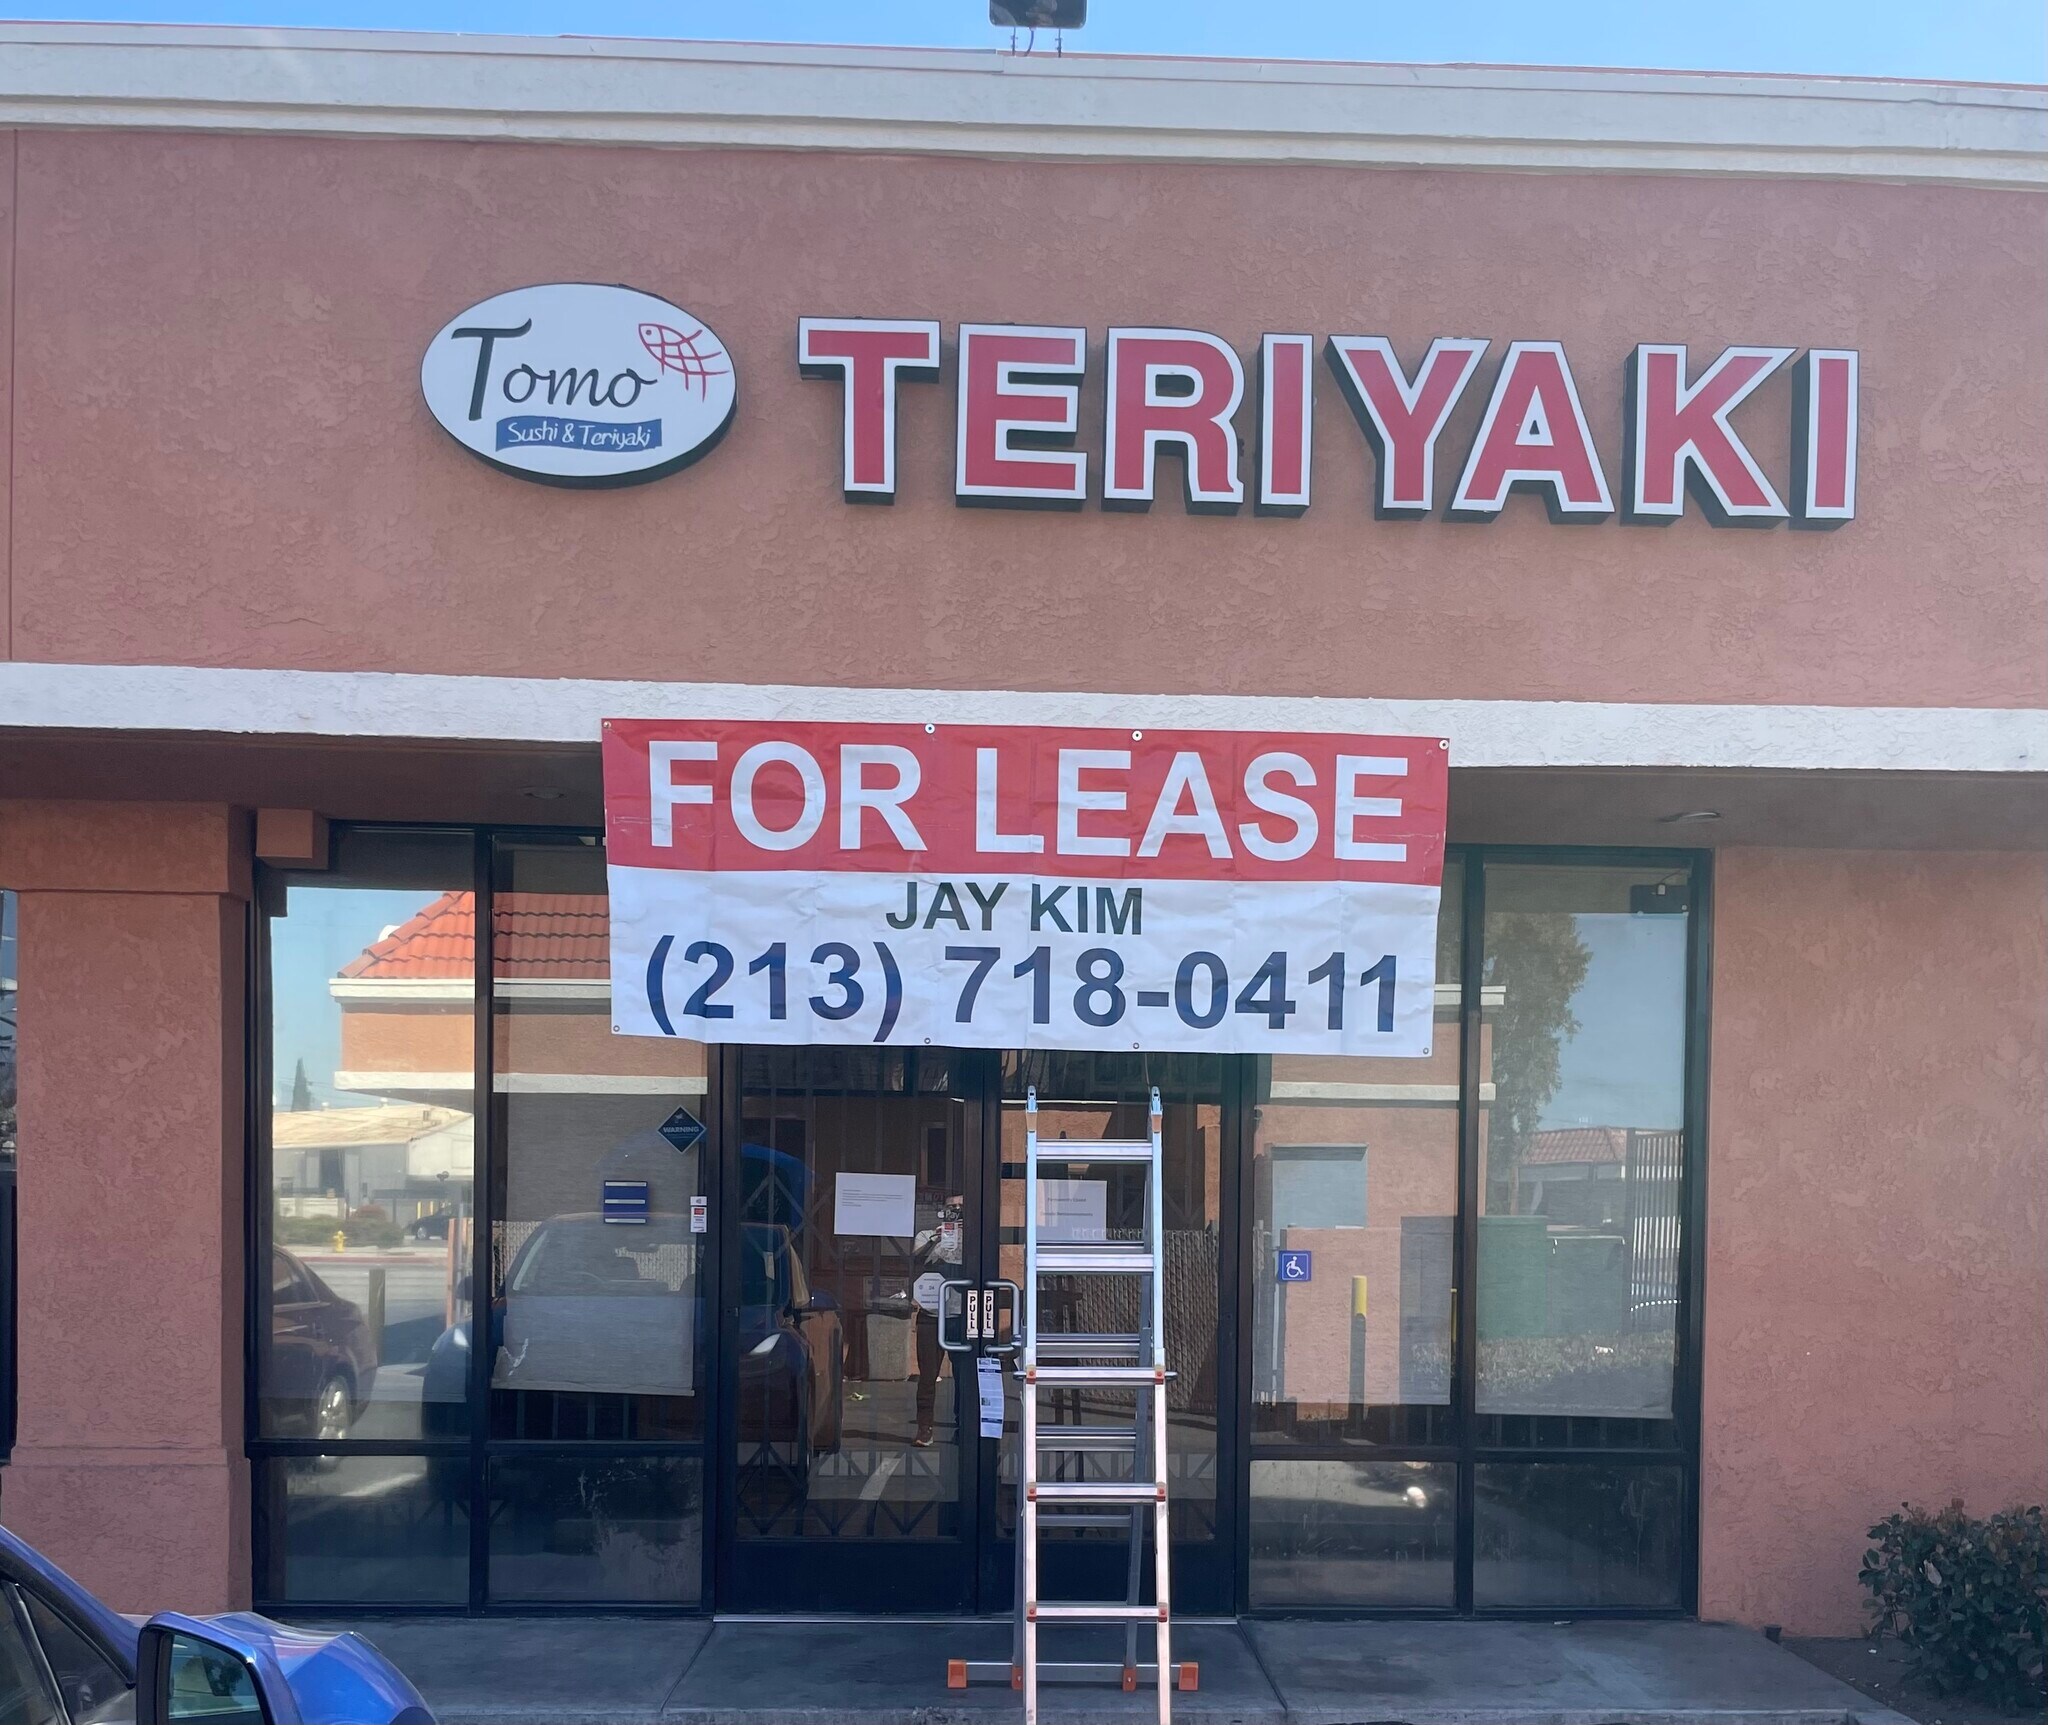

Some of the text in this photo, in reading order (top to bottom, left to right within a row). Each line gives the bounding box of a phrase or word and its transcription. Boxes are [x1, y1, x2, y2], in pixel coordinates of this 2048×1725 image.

[451, 318, 658, 421] Tomo
[798, 317, 1859, 520] TERIYAKI
[508, 421, 651, 450] Sushi & Teriyaki
[648, 740, 1409, 864] FOR LEASE
[886, 881, 1143, 936] JAY KIM
[646, 934, 1397, 1043] (213) 718-0411
[945, 1209, 960, 1220] Pay
